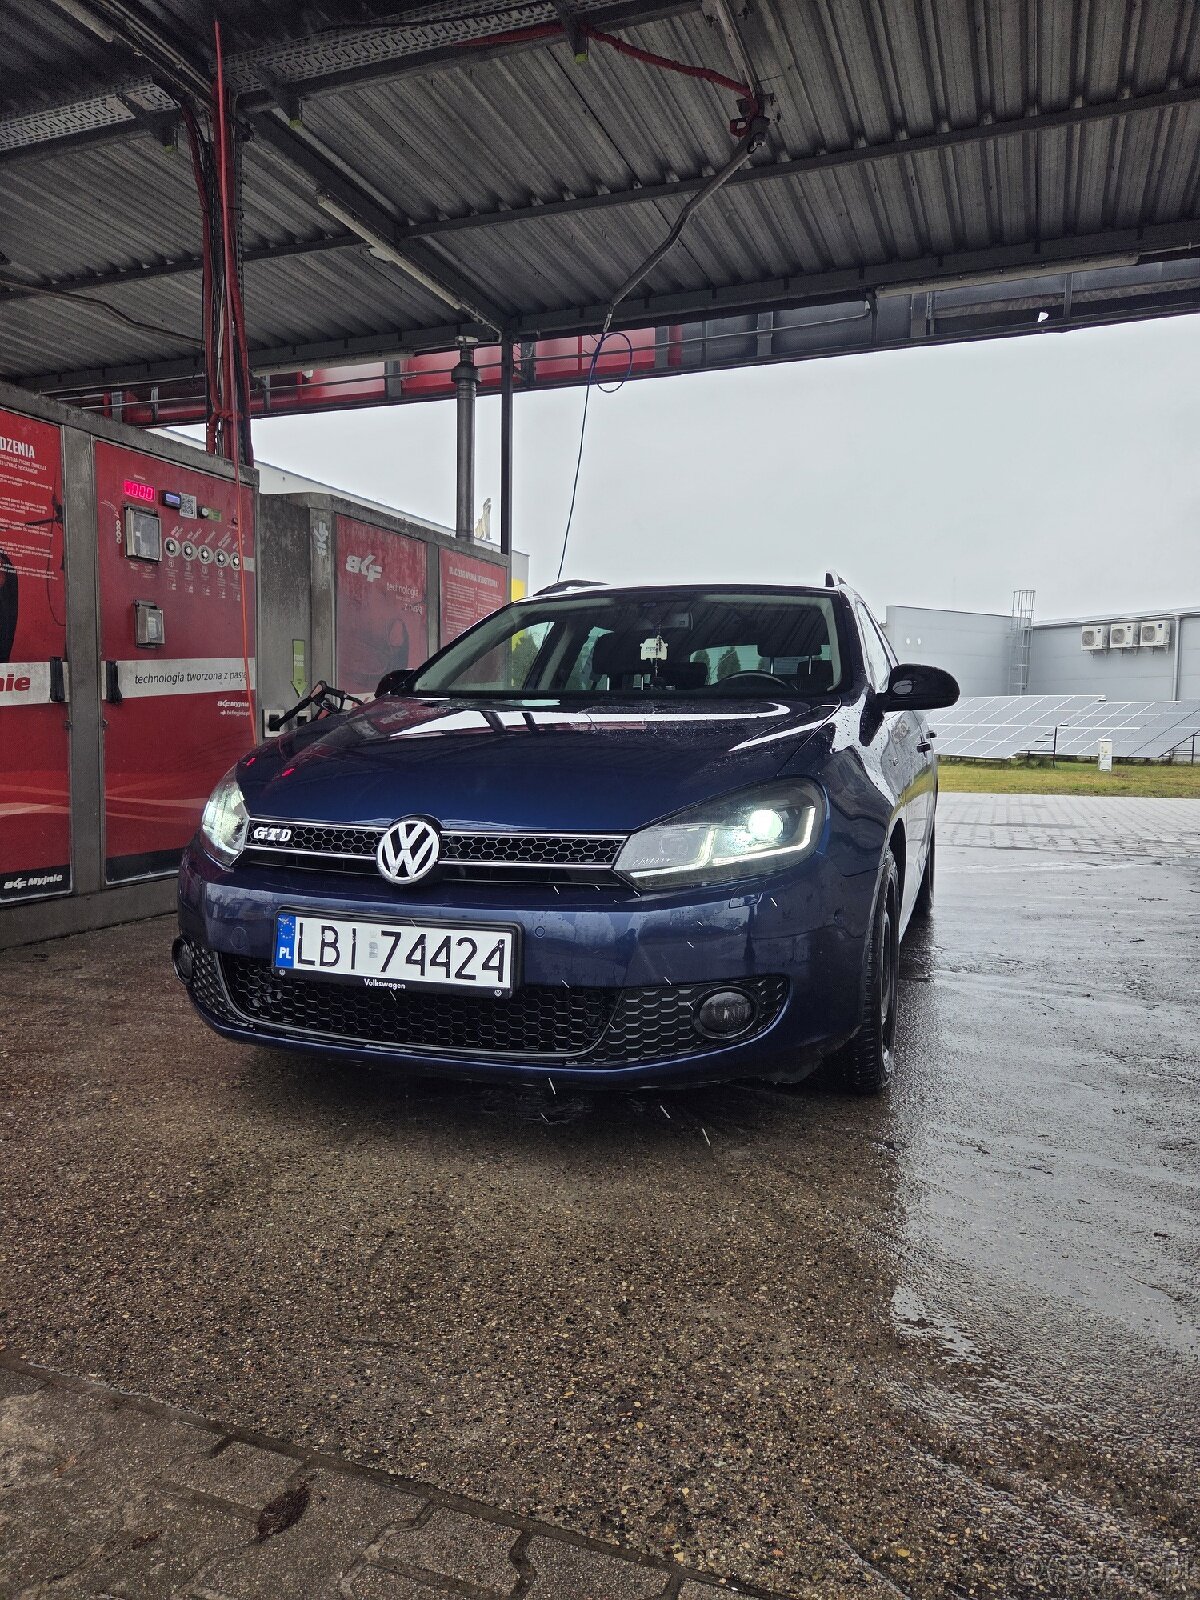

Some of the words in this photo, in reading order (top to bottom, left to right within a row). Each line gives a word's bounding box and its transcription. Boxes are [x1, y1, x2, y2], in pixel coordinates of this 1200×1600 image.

[0, 436, 35, 459] DZENIA
[346, 554, 383, 583] BKF
[135, 671, 184, 685] technologia
[187, 671, 223, 682] tworzona
[224, 672, 229, 680] z
[253, 826, 292, 842] GTD
[28, 874, 63, 886] Myjnie
[279, 946, 292, 959] PL
[297, 922, 357, 971] LBI
[380, 929, 506, 983] 74424
[363, 978, 407, 990] Volkswagen
